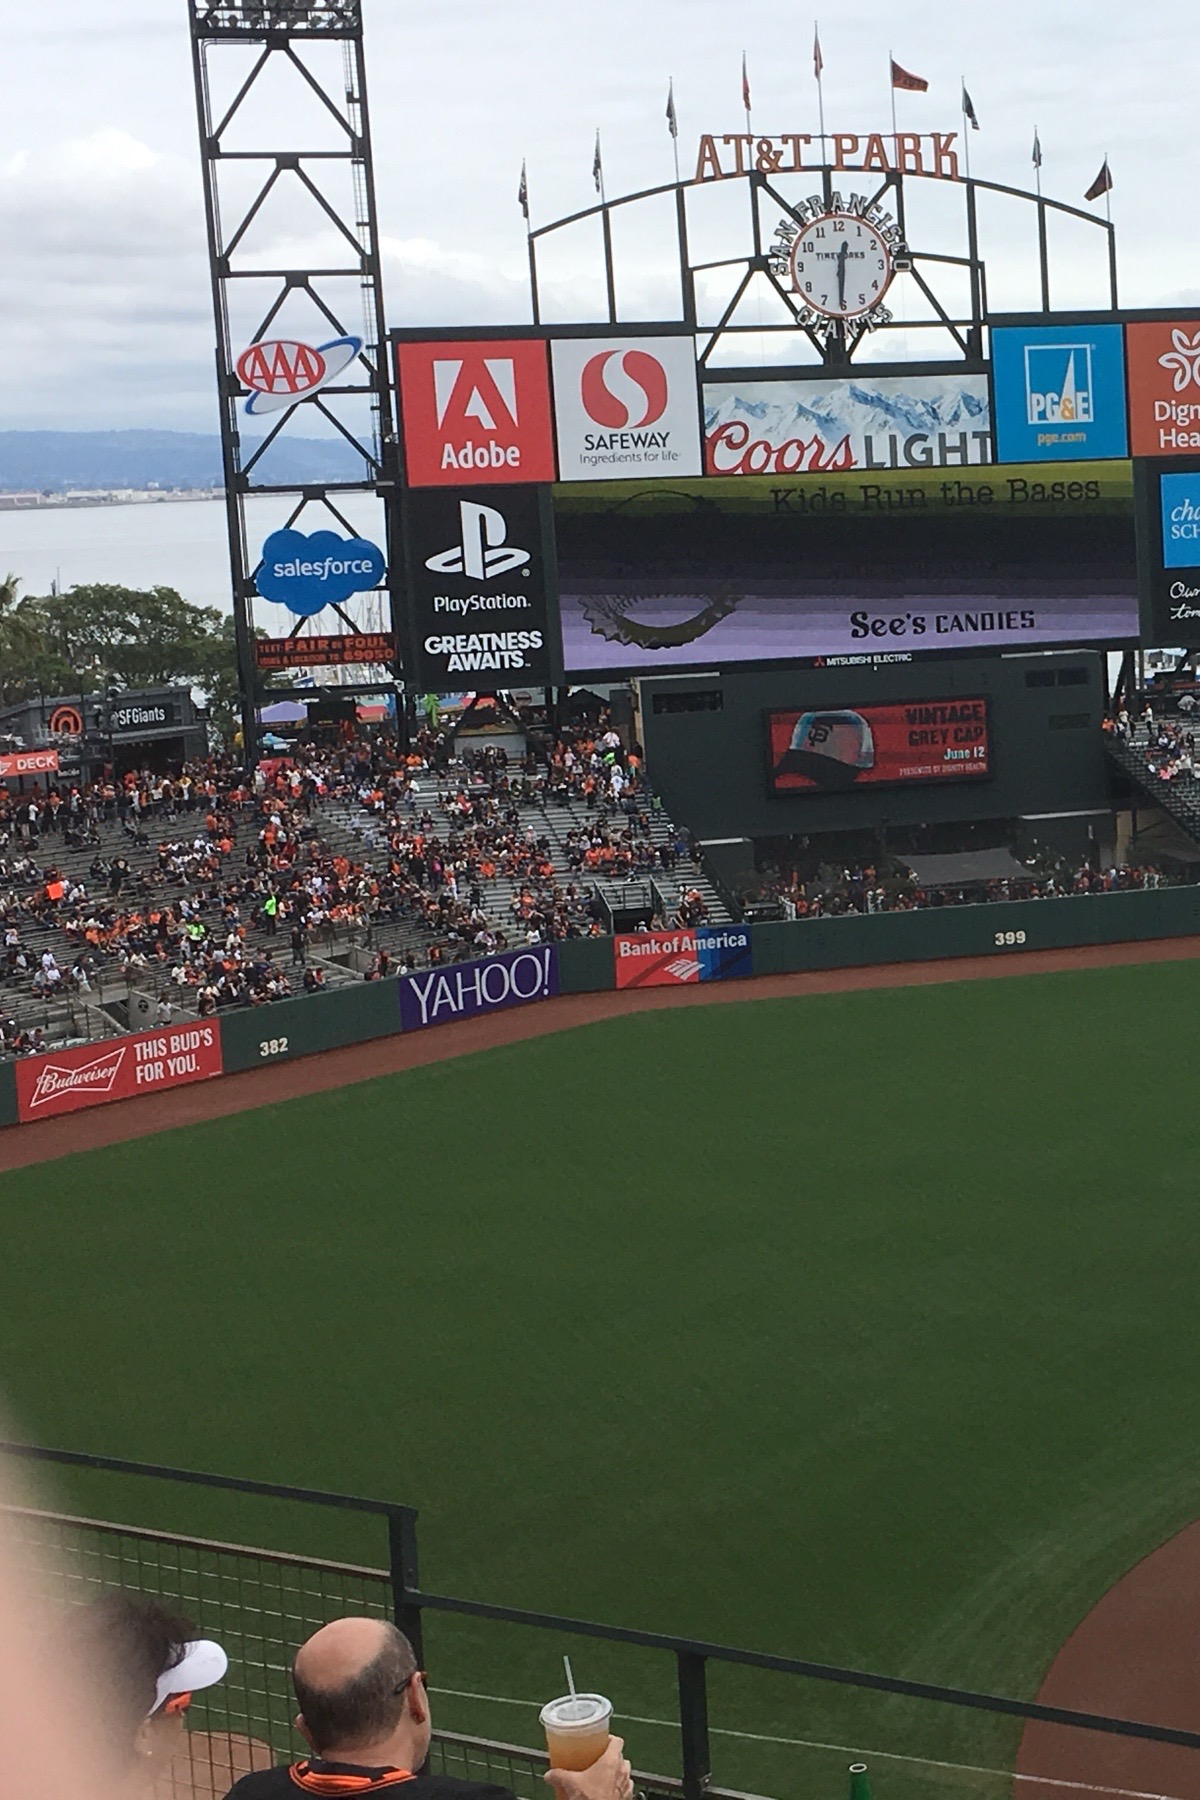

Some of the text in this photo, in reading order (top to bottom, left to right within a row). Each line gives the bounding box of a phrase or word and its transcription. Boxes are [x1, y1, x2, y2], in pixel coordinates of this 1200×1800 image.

[694, 132, 961, 183] AT&T PARK
[769, 191, 912, 276] SAN FRANCISCO
[816, 227, 826, 238] 11
[833, 221, 845, 232] 12
[856, 226, 862, 237] 1
[802, 242, 814, 253] 10
[870, 239, 877, 251] 2
[797, 261, 804, 273] 9
[877, 259, 884, 270] 3
[805, 281, 812, 293] 8
[871, 279, 878, 291] 4
[821, 294, 828, 306] 7
[858, 293, 866, 305] 5
[796, 303, 893, 339] GIANTS
[247, 340, 322, 393] AAA
[1031, 391, 1090, 422] PG&E
[584, 431, 670, 451] SAFEWAY
[704, 420, 991, 475] Coors LIGHT
[1037, 432, 1087, 446] pge.com
[441, 440, 520, 470] Adobe
[580, 450, 679, 466] Ingredients for life
[770, 478, 1100, 514] Kids Run the Bases
[273, 557, 372, 580] salesforce
[850, 610, 1035, 639] See's CANDIES
[284, 640, 329, 653] FAIR
[344, 636, 387, 648] FOUL
[425, 631, 543, 655] GREATNESS
[343, 648, 394, 660] 69050
[447, 650, 524, 672] AWAITS
[826, 653, 912, 666] MITSUBISHI ELECTRIC
[115, 707, 166, 725] SFGiants
[905, 704, 983, 725] VINTAGE
[908, 726, 984, 746] GREY CAP
[17, 755, 56, 770] DECK
[943, 746, 985, 760] June 12
[619, 932, 747, 957] Bank of America
[995, 931, 1026, 946] 399
[408, 947, 551, 1024] YAHOO!
[133, 1028, 213, 1061] THIS BUD'S
[259, 1037, 288, 1057] 382
[135, 1054, 200, 1084] FOR YOU.
[36, 1065, 116, 1094] Budweiser
